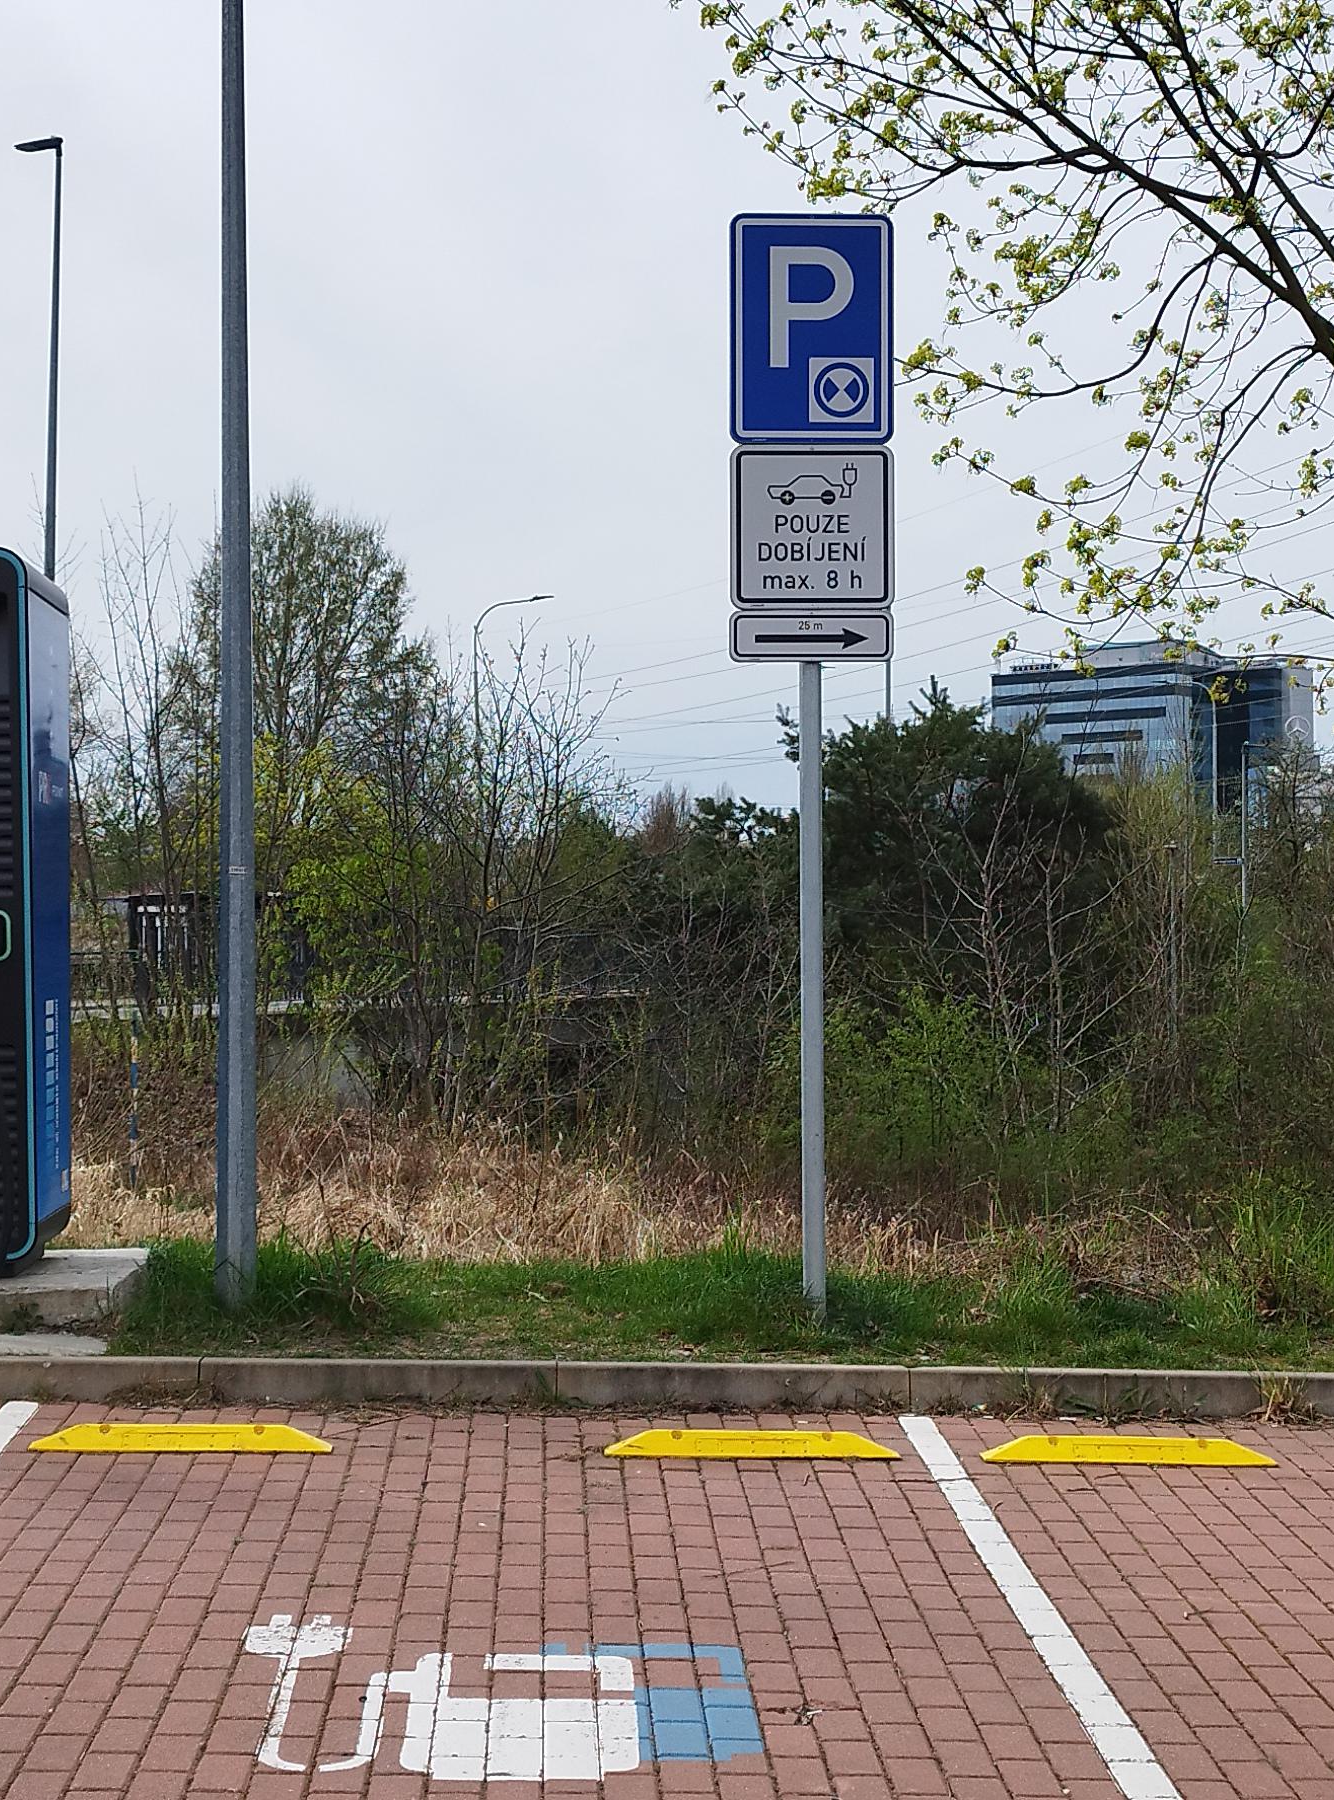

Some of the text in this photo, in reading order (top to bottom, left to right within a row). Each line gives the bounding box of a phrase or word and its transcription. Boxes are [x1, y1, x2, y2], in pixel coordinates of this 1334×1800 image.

[769, 245, 854, 367] P
[774, 515, 850, 534] POUZE
[758, 536, 866, 562] DOBÍJENÍ
[762, 570, 862, 590] max. 8 h
